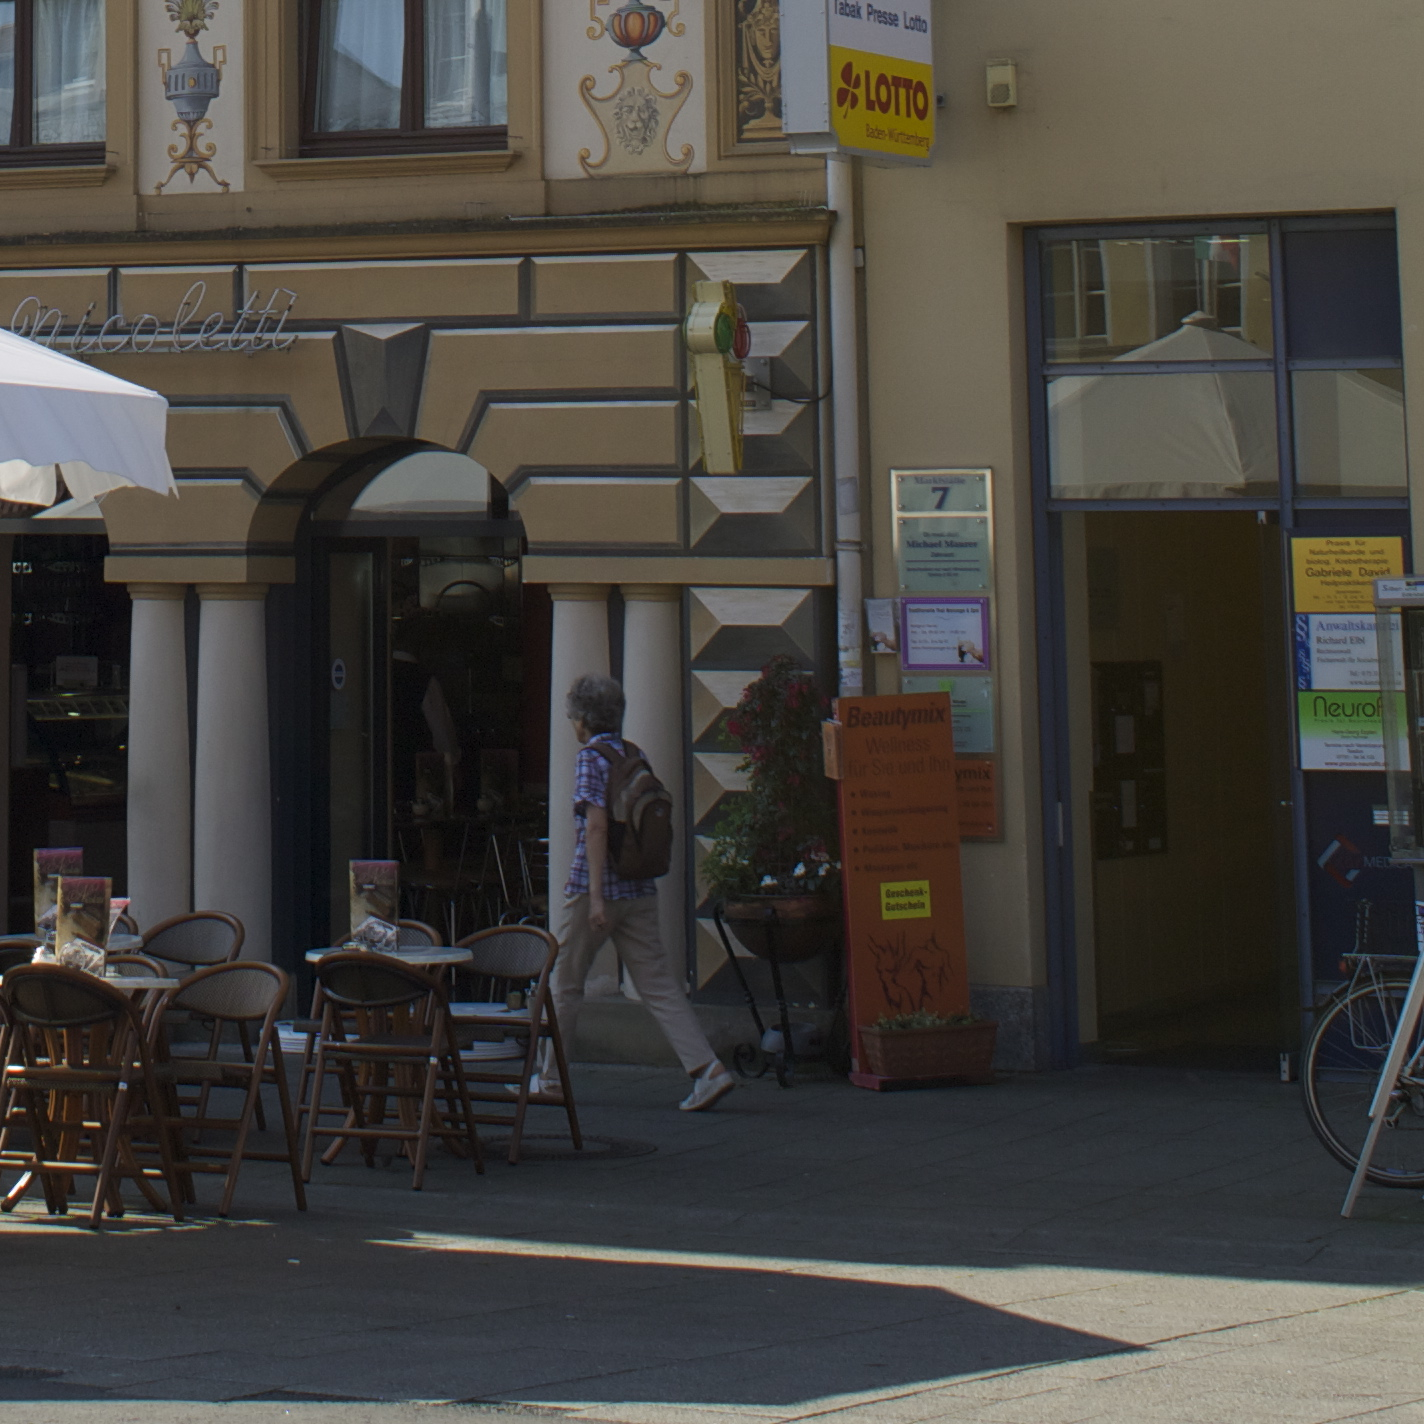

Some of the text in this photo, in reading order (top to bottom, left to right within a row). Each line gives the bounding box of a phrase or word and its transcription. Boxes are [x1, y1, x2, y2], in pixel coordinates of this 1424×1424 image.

[866, 2, 899, 28] Presse
[903, 11, 928, 34] Lotto
[864, 69, 929, 121] LOTTO
[931, 486, 950, 510] 7
[906, 539, 942, 549] Michael
[1305, 566, 1391, 578] Gabriele David
[846, 701, 946, 730] Beautymix
[865, 736, 932, 755] Wellness
[847, 755, 950, 777] für Sie und Ihn
[885, 887, 928, 898] Geschenk-
[885, 900, 926, 911] Gutschein
